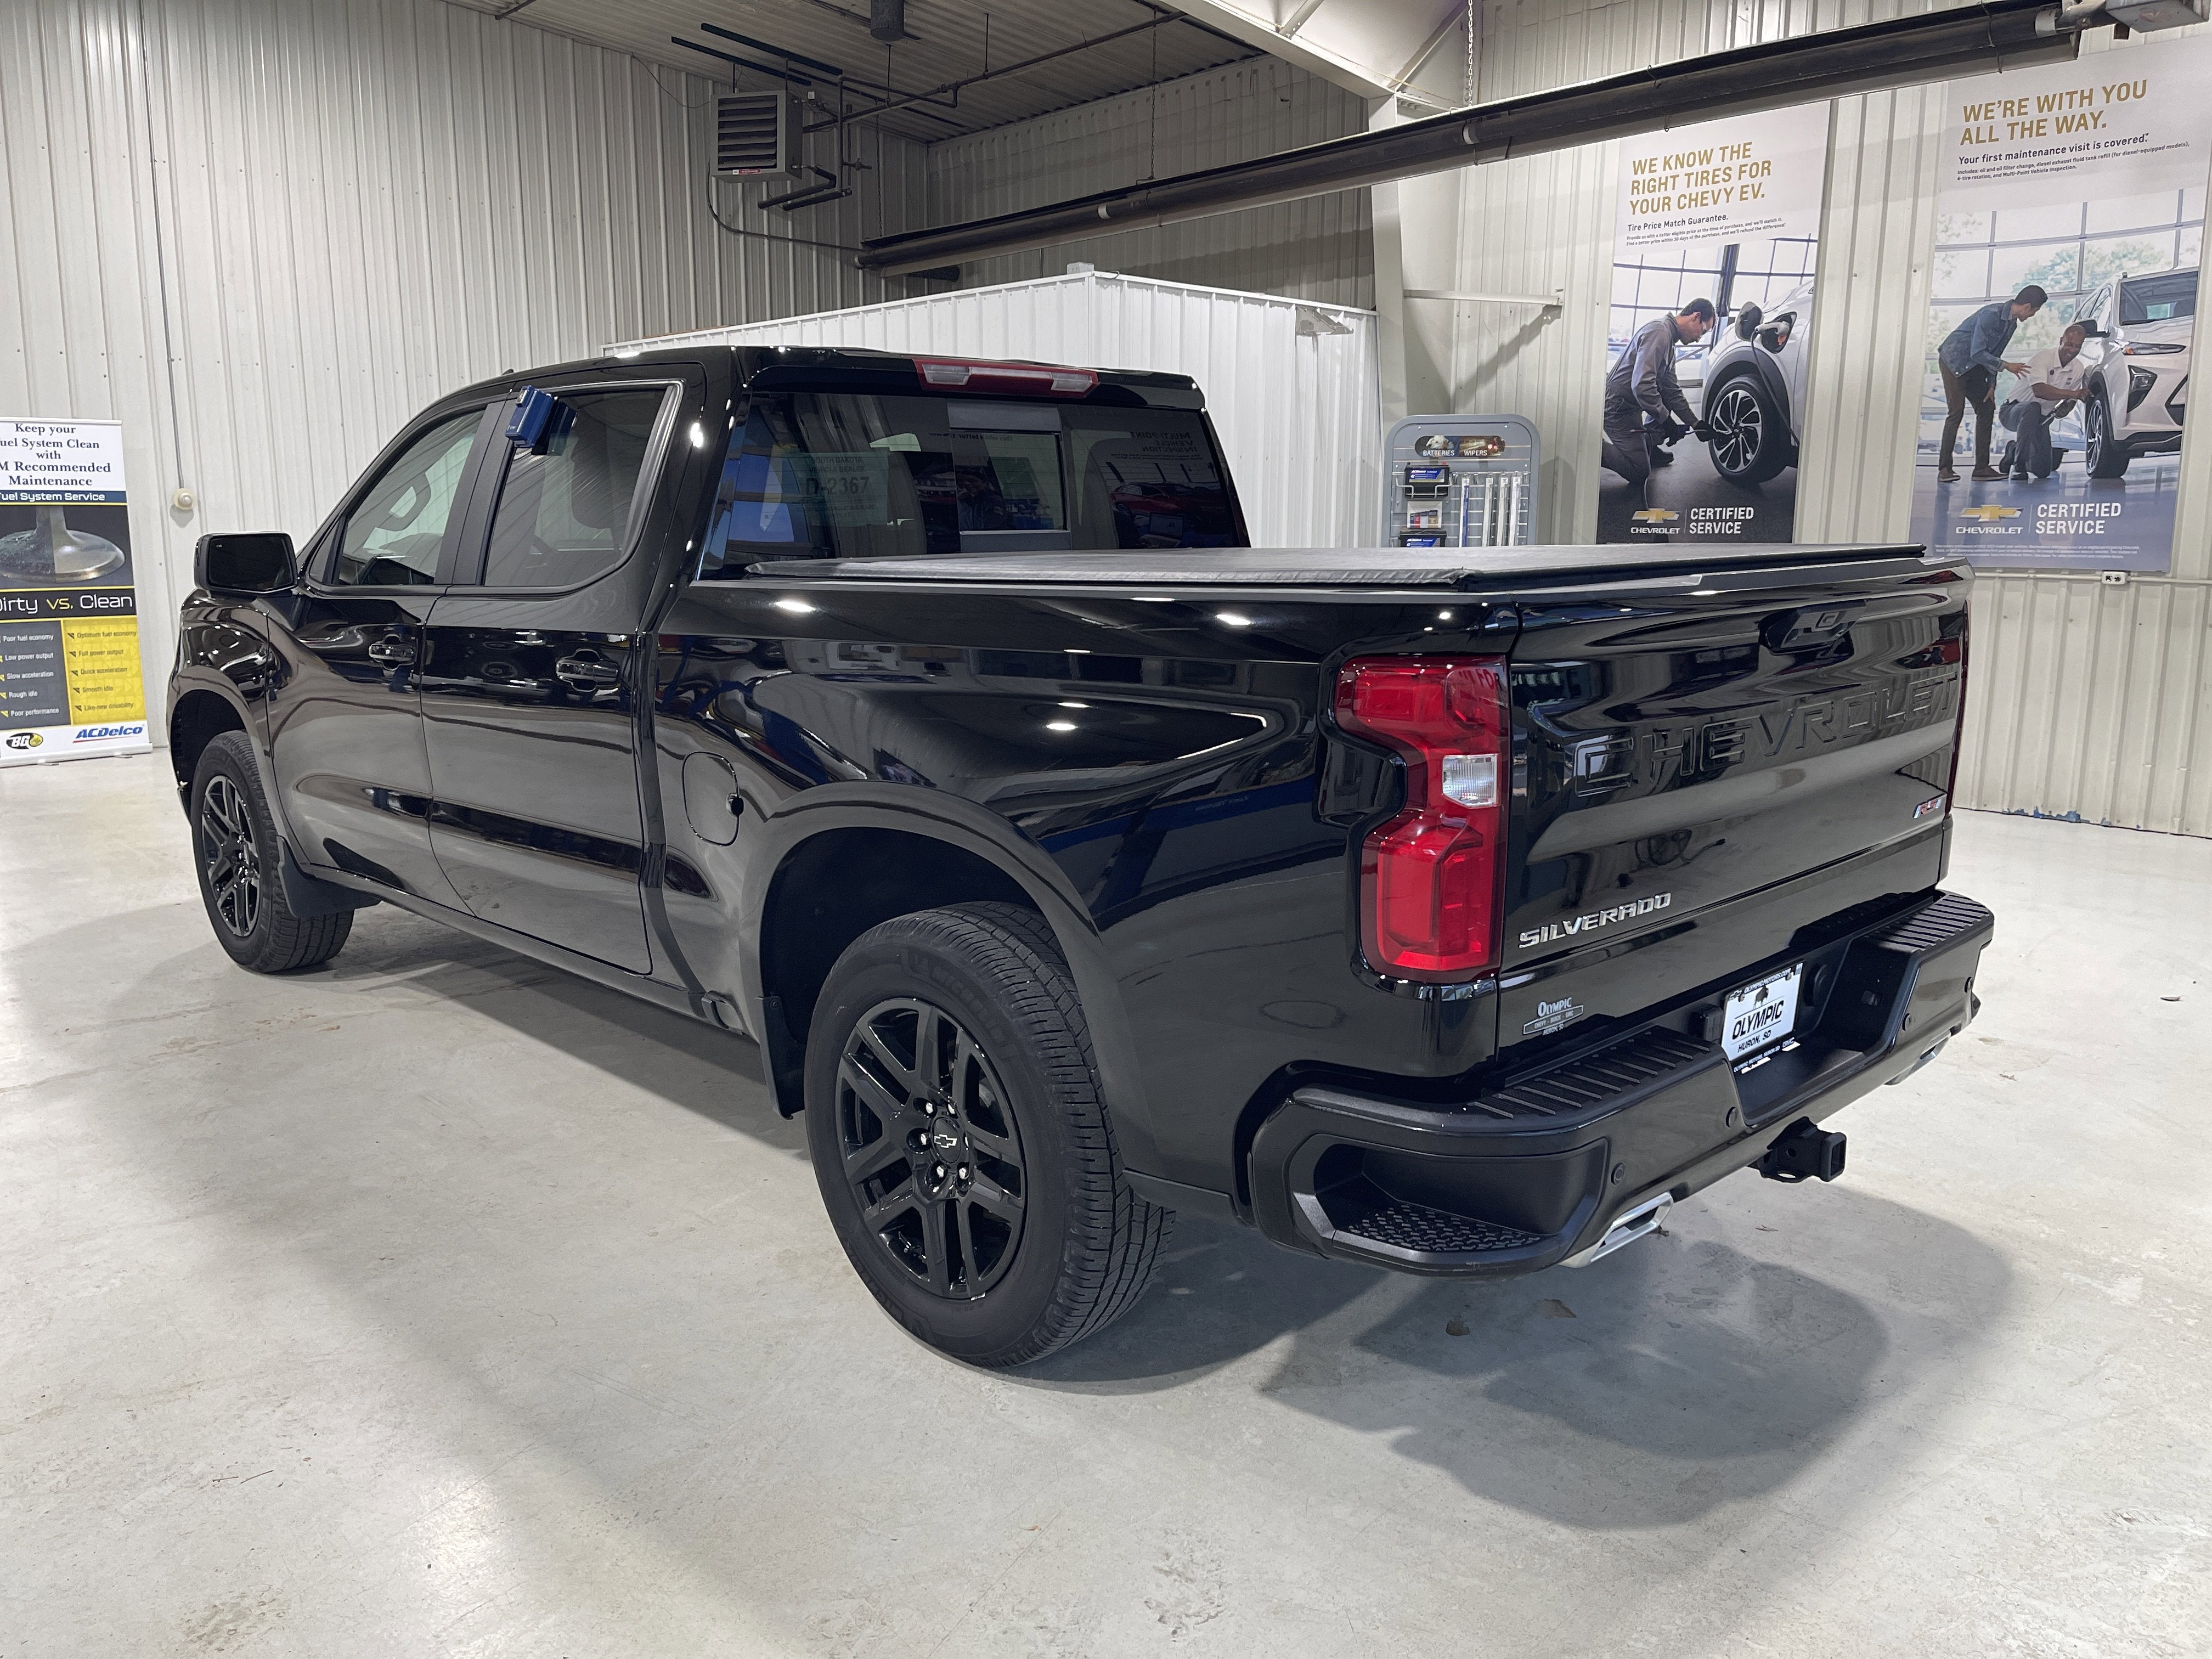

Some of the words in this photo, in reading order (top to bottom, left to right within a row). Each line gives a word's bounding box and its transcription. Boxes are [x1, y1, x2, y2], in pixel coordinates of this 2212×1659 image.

[1963, 98, 2029, 122] WE'RE
[2036, 88, 2094, 113] WITH
[2102, 79, 2147, 104] YOU
[1960, 125, 2000, 146] ALL
[2007, 118, 2047, 140] THE
[2055, 110, 2107, 134] WAY.
[1959, 156, 1979, 165] Your
[1982, 153, 2002, 163] first
[2005, 146, 2067, 160] maintenance
[2069, 143, 2090, 153] visit
[2093, 140, 2101, 149] is
[2123, 145, 2165, 156] diesel-equipped
[1632, 157, 1658, 176] WE
[1663, 148, 1714, 171] KNOW
[1719, 142, 1752, 162] THE
[1630, 174, 1679, 196] RIGHT
[1684, 166, 1731, 189] TIRES
[1738, 160, 1771, 181] FOR
[1630, 196, 1671, 216] YOUR
[1677, 187, 1734, 211] CHEVY
[1739, 182, 1765, 201] EV.
[1663, 218, 1686, 228] Match
[1688, 215, 1728, 225] Guarantee.
[15, 423, 45, 436] Keep
[49, 426, 76, 436] your
[0, 438, 18, 447] uel
[22, 438, 63, 450] System
[67, 439, 99, 449] Clean
[36, 450, 61, 459] with
[0, 461, 9, 471] M
[14, 461, 111, 472] Recommended
[9, 475, 92, 486] Maintenance
[805, 476, 870, 495] D-2367
[0, 492, 18, 500] uel
[20, 492, 62, 503] System
[64, 493, 105, 501] Service
[1690, 506, 1754, 520] CERTIFIED
[2036, 503, 2121, 518] CERTIFIED
[1689, 522, 1741, 534] SERVICE
[1955, 526, 2023, 535] CHEVROLET
[2035, 520, 2105, 534] SERVICE
[47, 598, 73, 610] vs.
[80, 595, 133, 609] Clean
[25, 708, 59, 716] performance
[76, 726, 143, 739] ACDelco
[1575, 673, 1957, 797] CHEVROLET
[1913, 798, 1942, 819] RST
[1519, 891, 1672, 949] SILVERADO
[1538, 997, 1572, 1017] OLYMPIC
[1732, 1000, 1785, 1040] OLYMPIC
[1737, 1035, 1760, 1053] HURON,
[1762, 1030, 1771, 1041] SD
